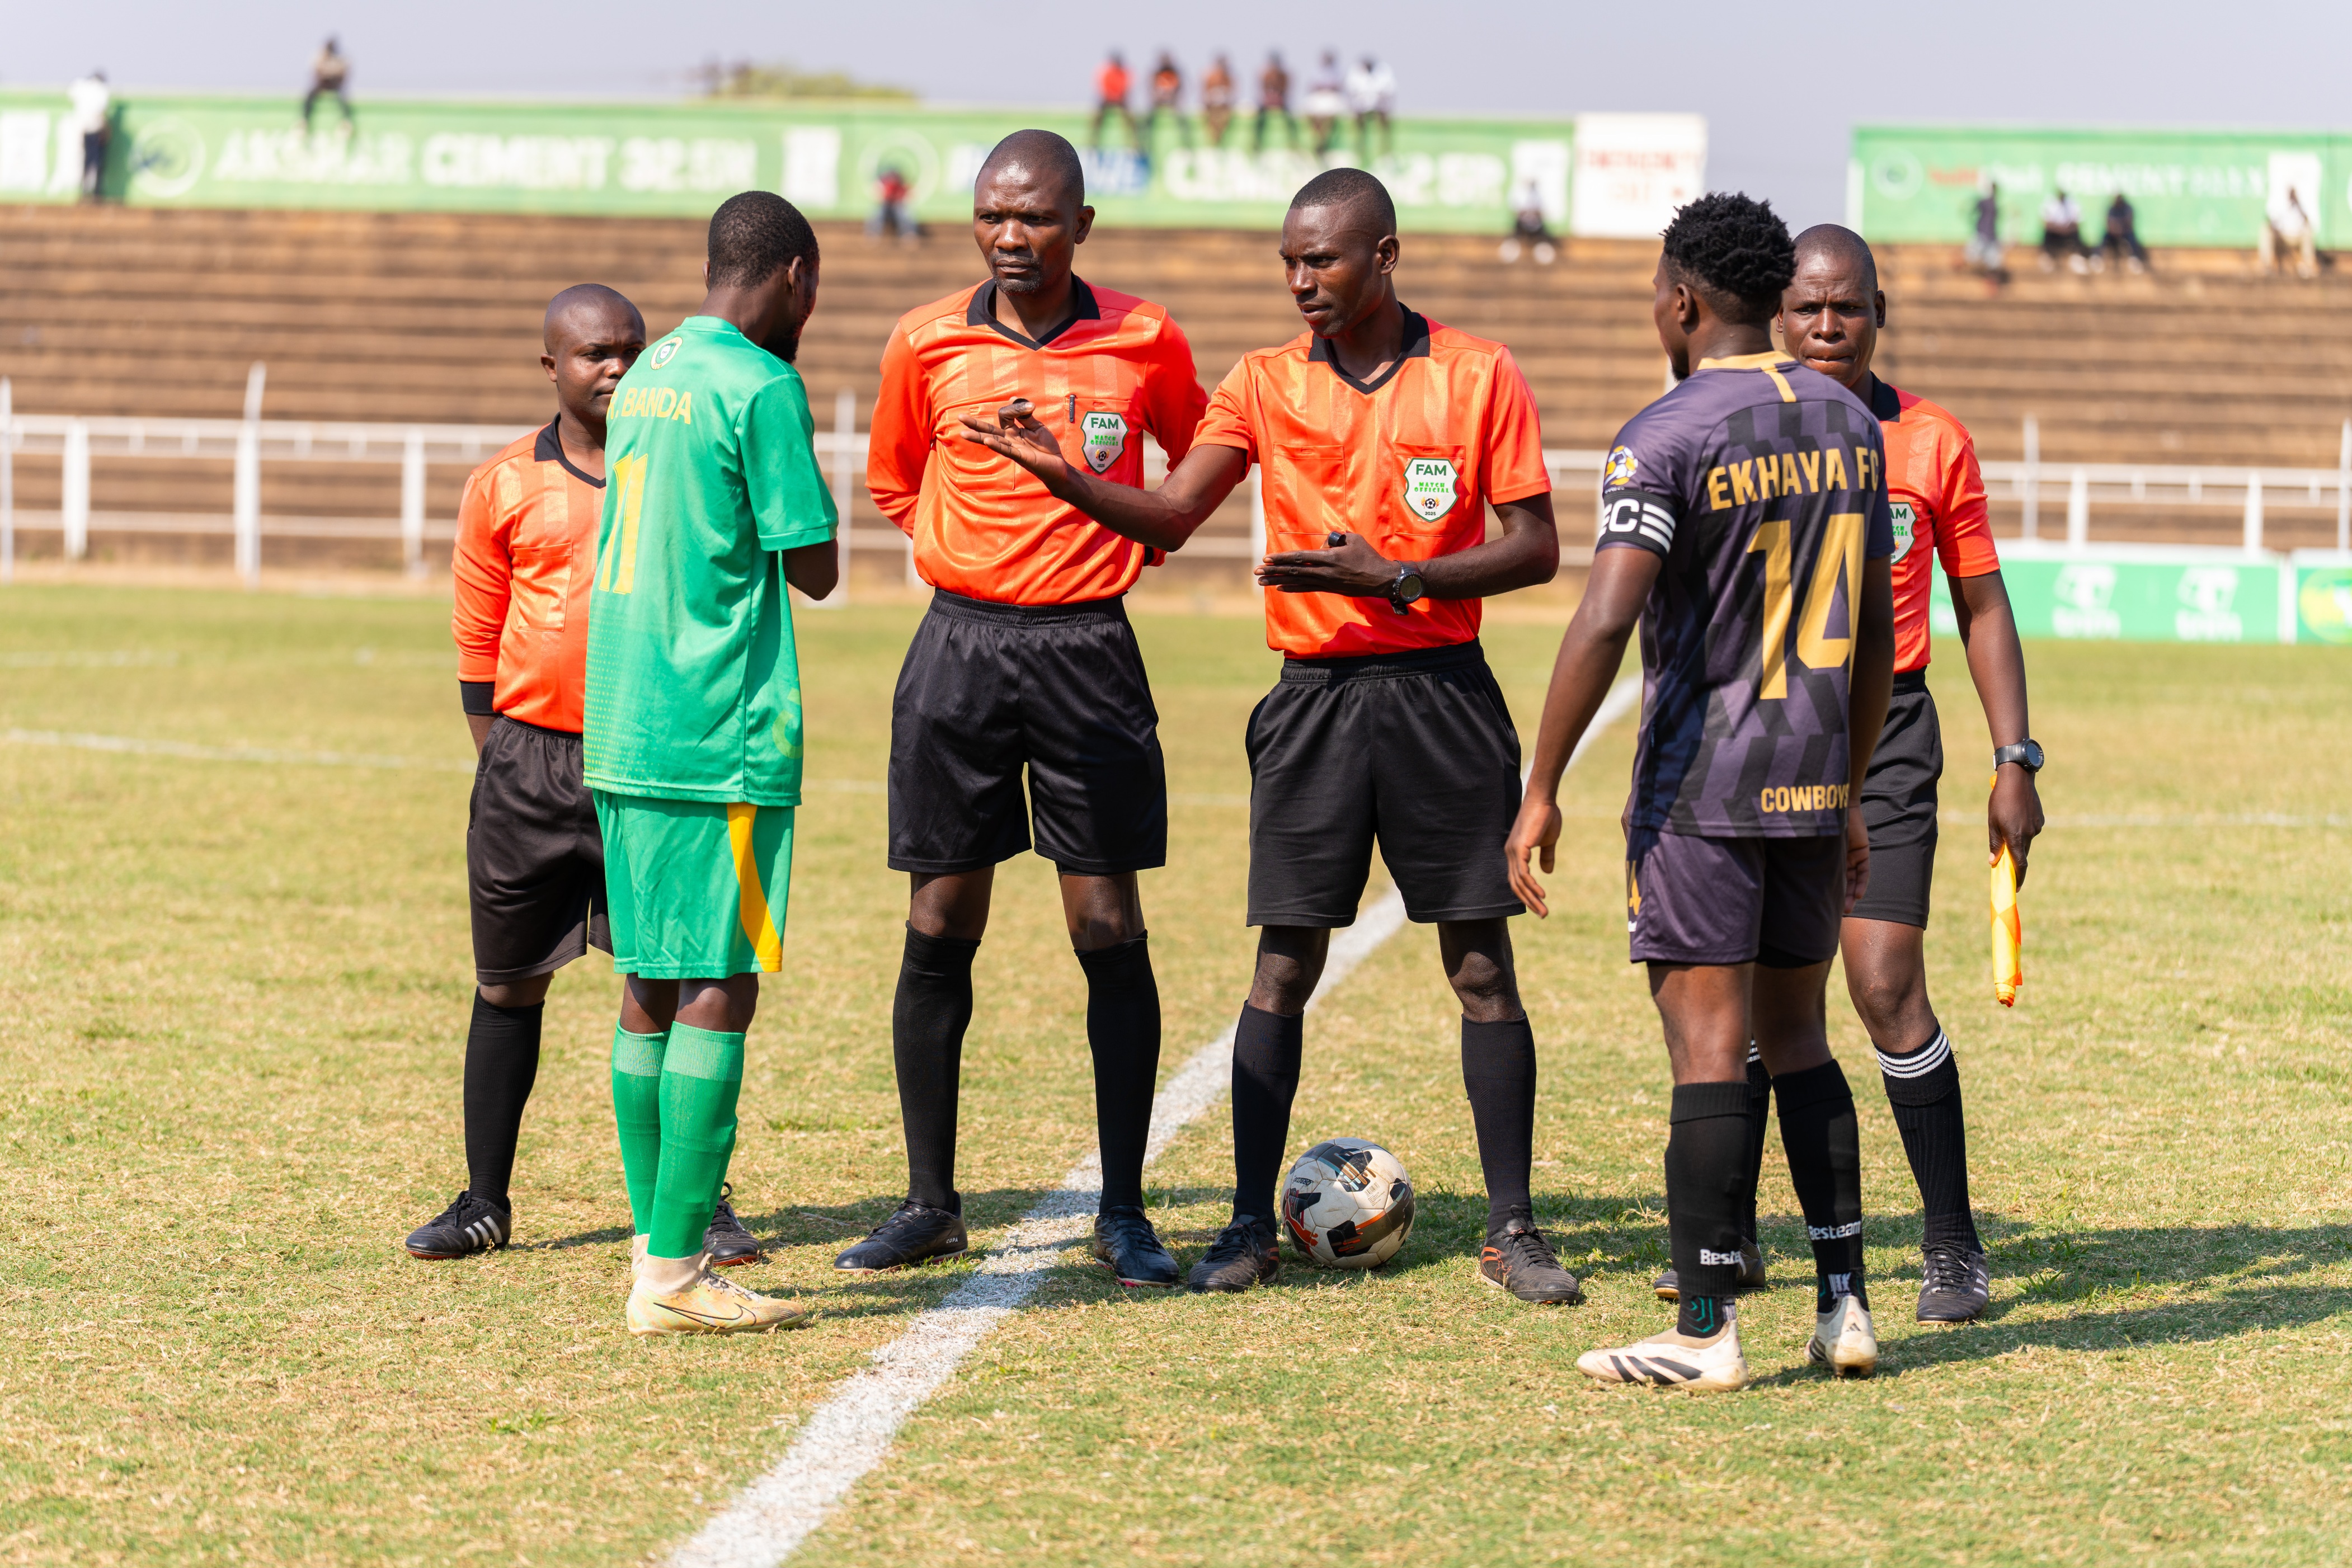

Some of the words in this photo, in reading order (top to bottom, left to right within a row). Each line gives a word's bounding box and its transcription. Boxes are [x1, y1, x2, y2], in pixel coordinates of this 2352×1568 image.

[621, 387, 692, 425] BANDA
[1091, 417, 1118, 430] FAM
[1416, 464, 1447, 476] FAM
[1707, 448, 1848, 510] EKHAYA
[1855, 446, 1879, 492] FC
[599, 452, 648, 595] 11
[1609, 498, 1640, 532] C
[1747, 513, 1865, 699] 14
[1808, 1220, 1861, 1241] Besteam
